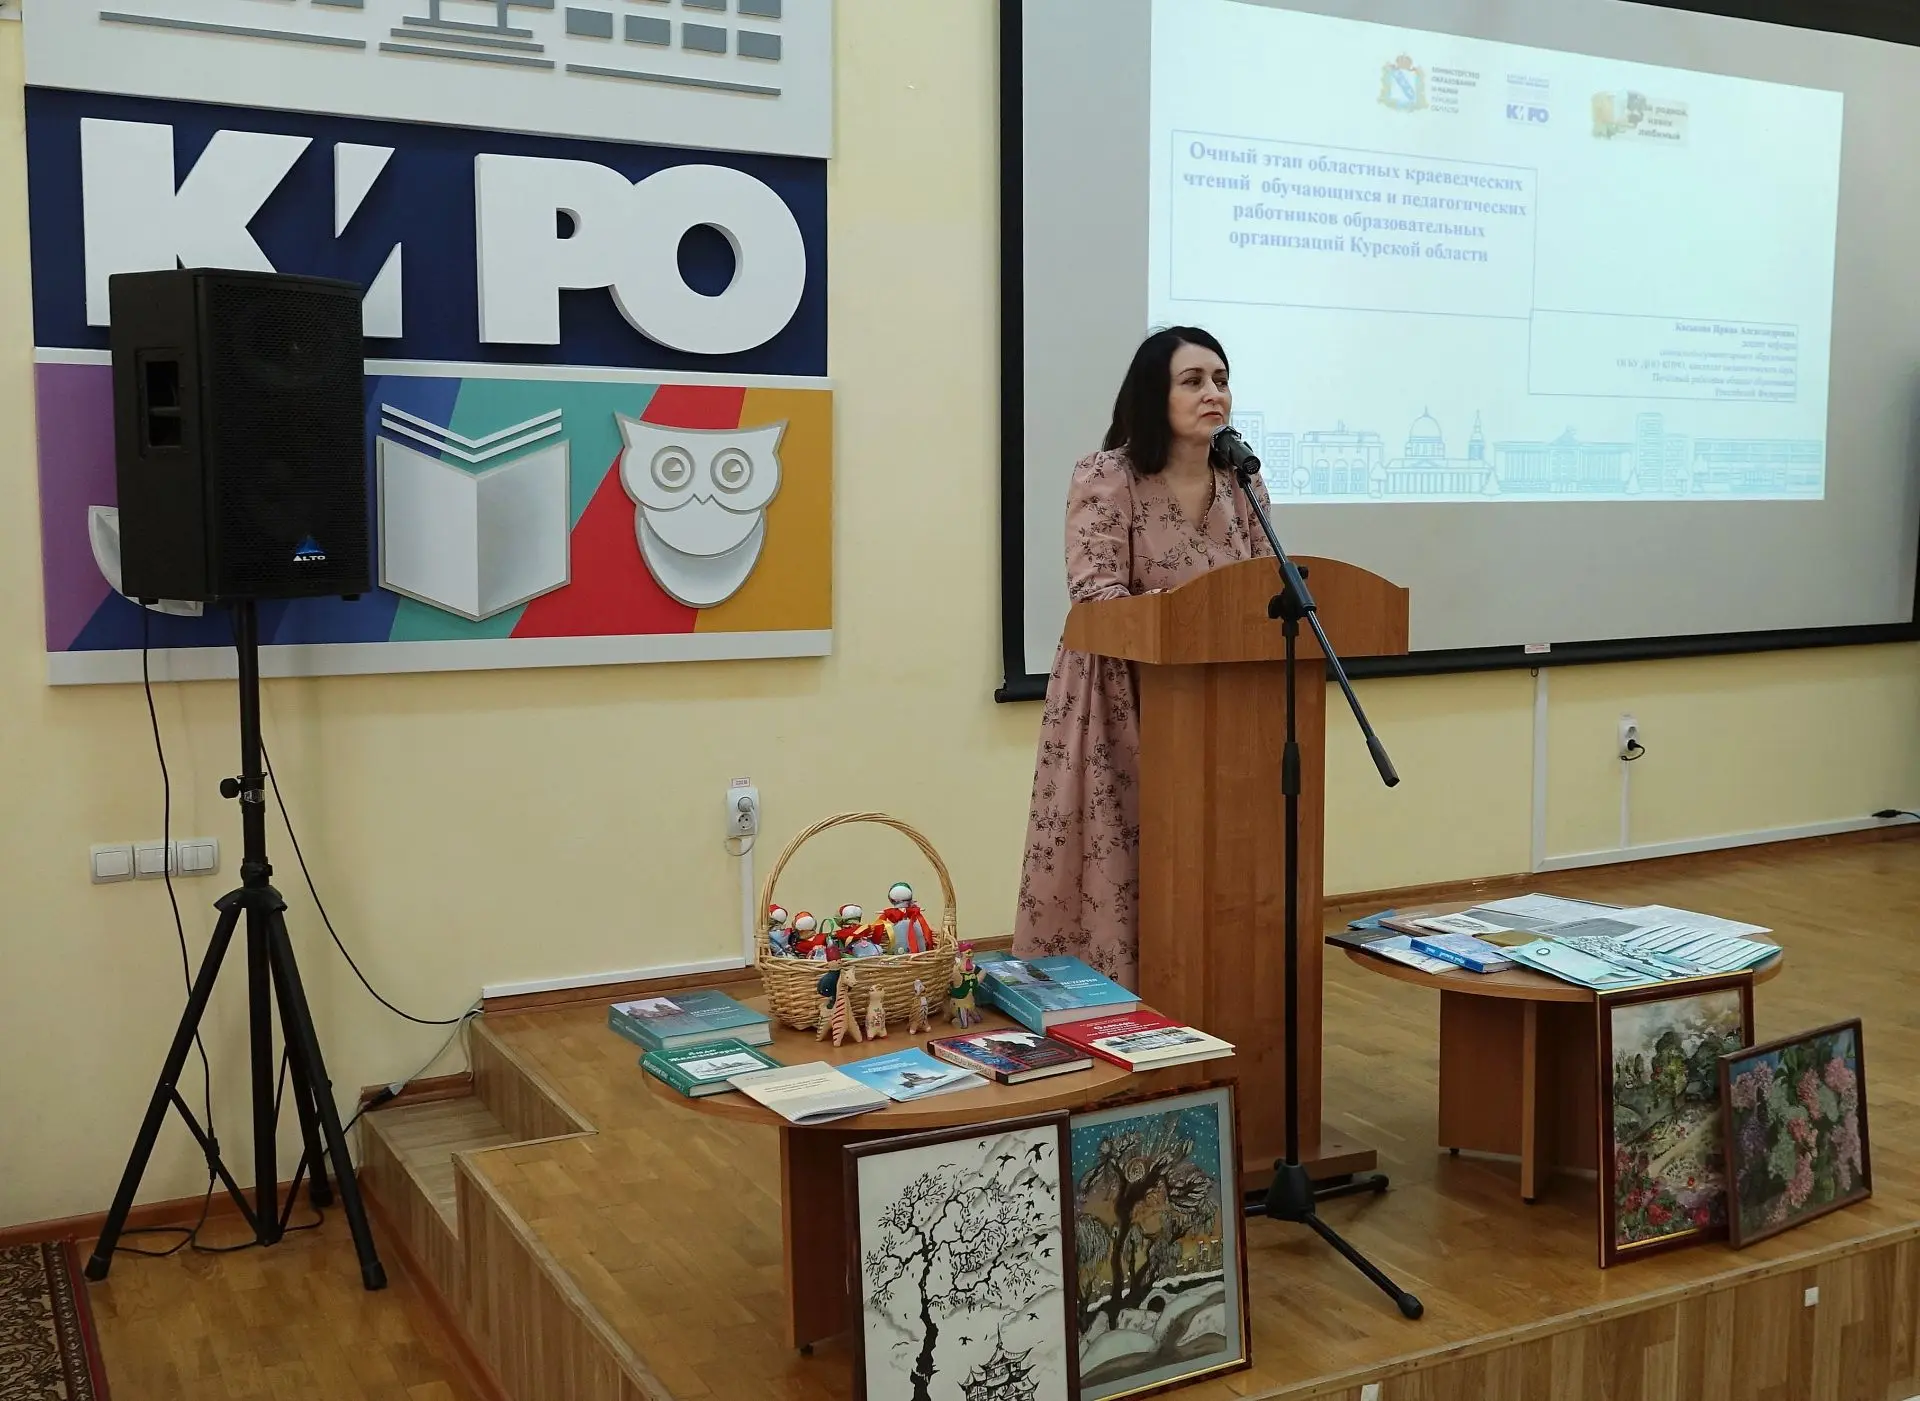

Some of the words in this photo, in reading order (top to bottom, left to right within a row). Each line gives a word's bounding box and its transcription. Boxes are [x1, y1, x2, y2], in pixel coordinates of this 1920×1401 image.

[1189, 141, 1257, 165] Очный
[1262, 152, 1303, 171] этап
[1308, 155, 1400, 180] областных
[1405, 168, 1523, 193] краеведческих
[1183, 170, 1251, 191] чтений
[1261, 177, 1382, 204] обучающихся
[1387, 192, 1397, 205] и
[1402, 192, 1527, 217] педагогических
[1233, 201, 1338, 226] работников
[1343, 214, 1486, 238] образовательных
[1229, 229, 1345, 252] организаций
[1350, 235, 1421, 260] Курской
[1425, 242, 1488, 263] области
